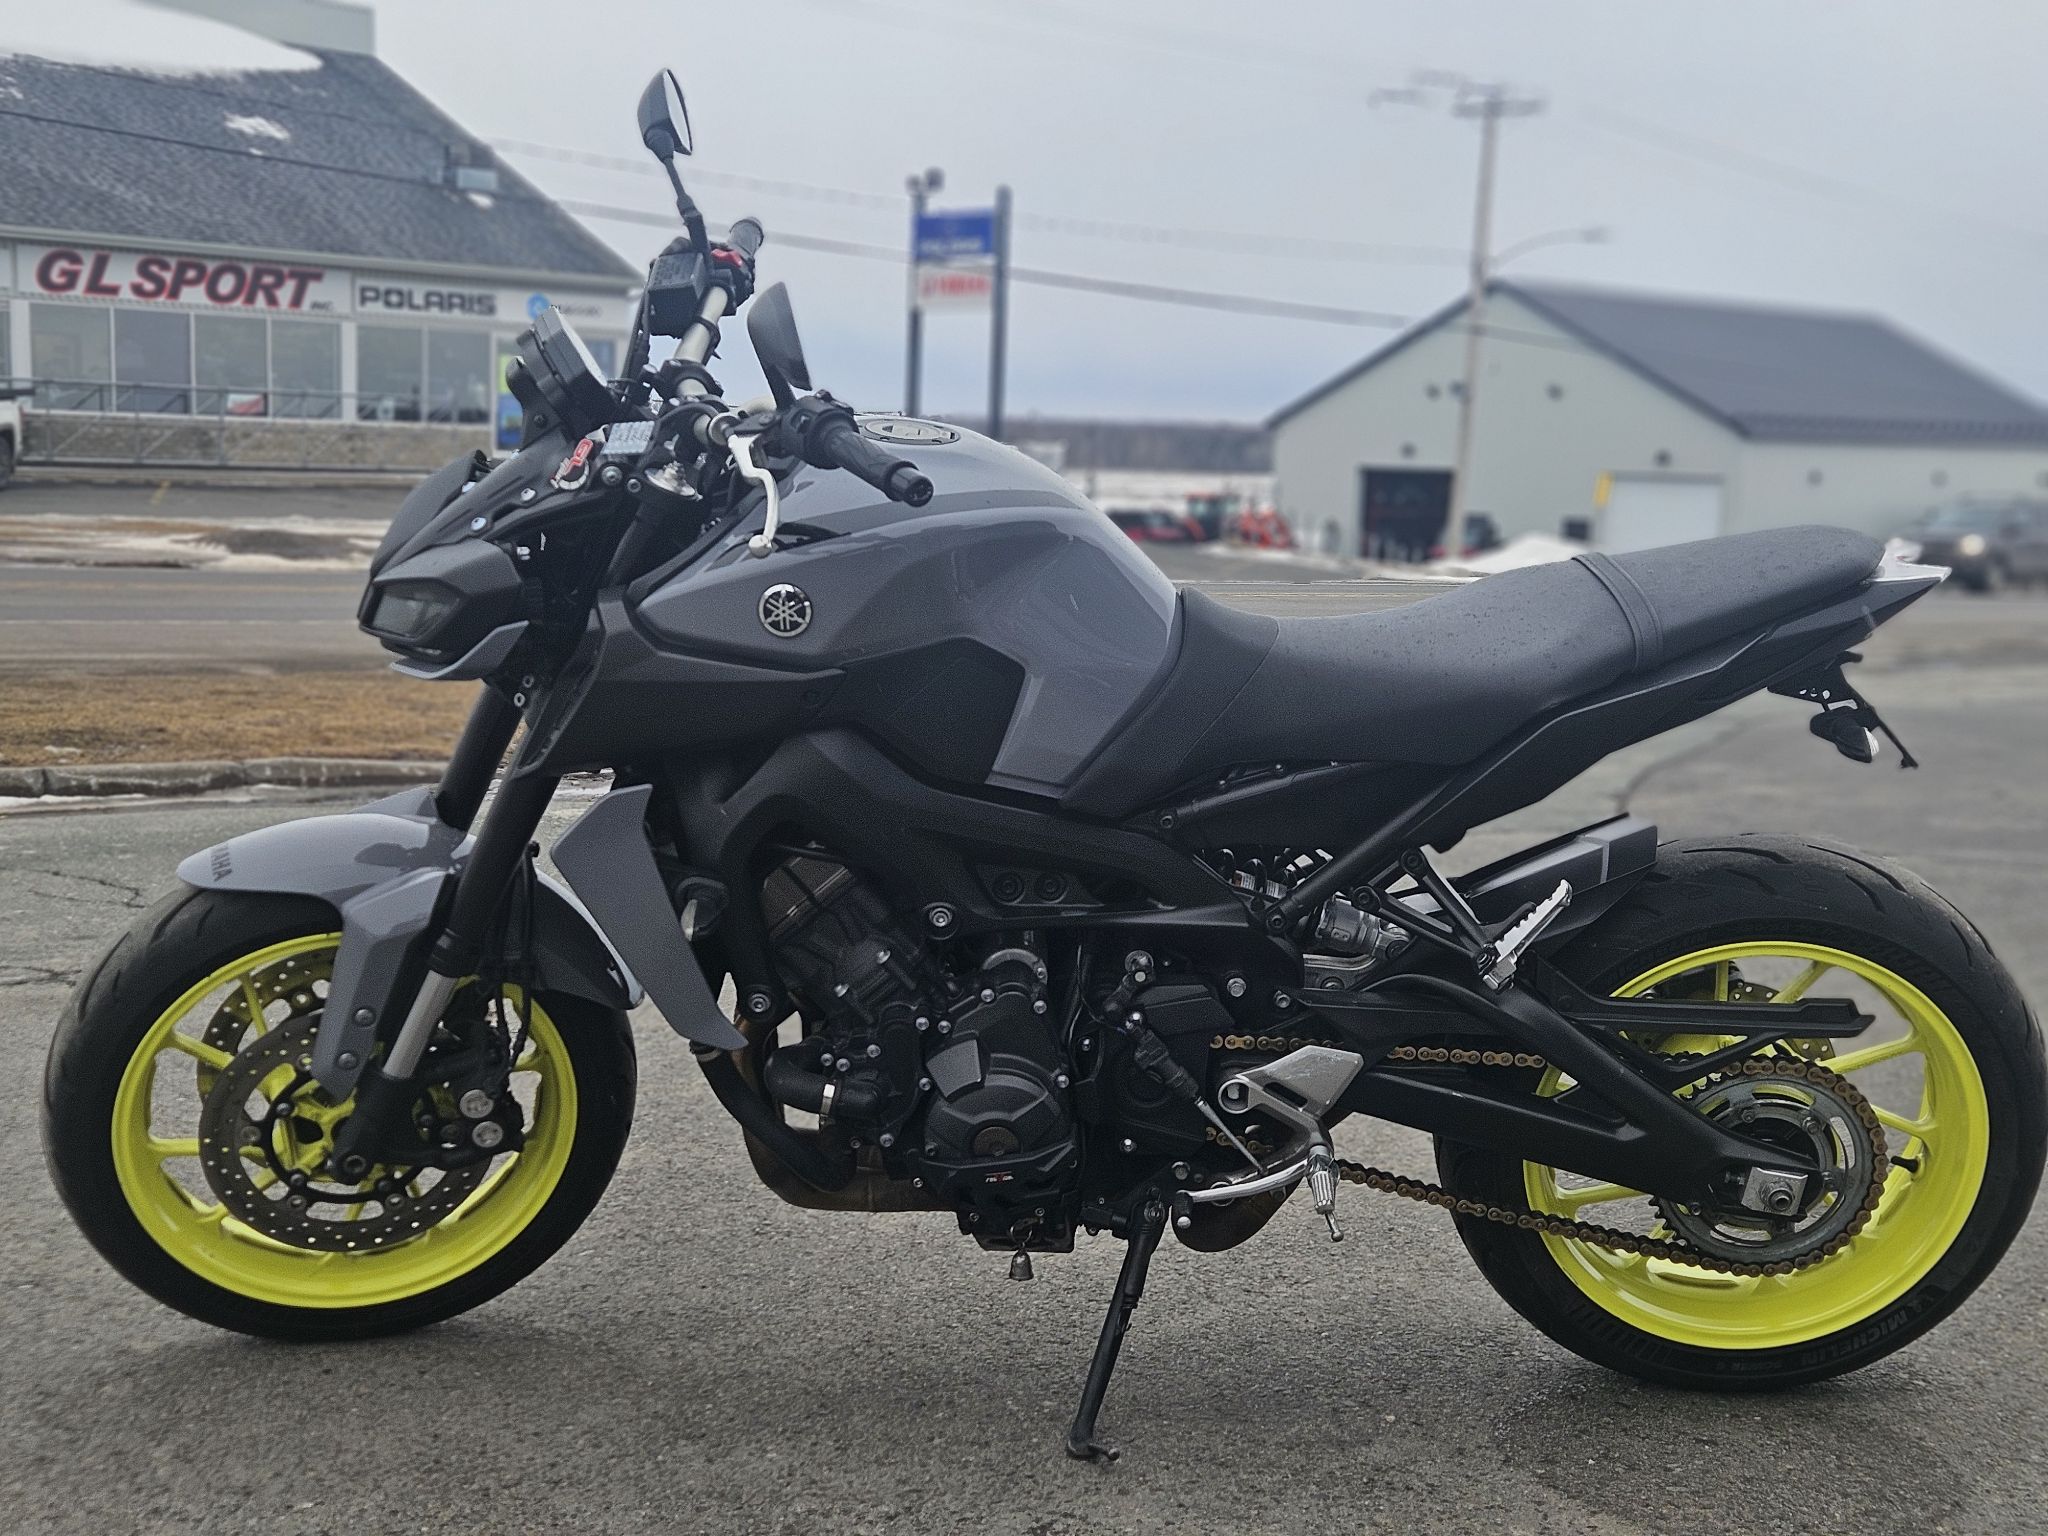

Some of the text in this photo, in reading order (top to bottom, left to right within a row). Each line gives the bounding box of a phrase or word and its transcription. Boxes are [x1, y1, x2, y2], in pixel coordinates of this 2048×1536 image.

[129, 255, 325, 309] SPORT
[359, 285, 497, 316] POLARIS
[1801, 1309, 1908, 1366] MICHELIN
